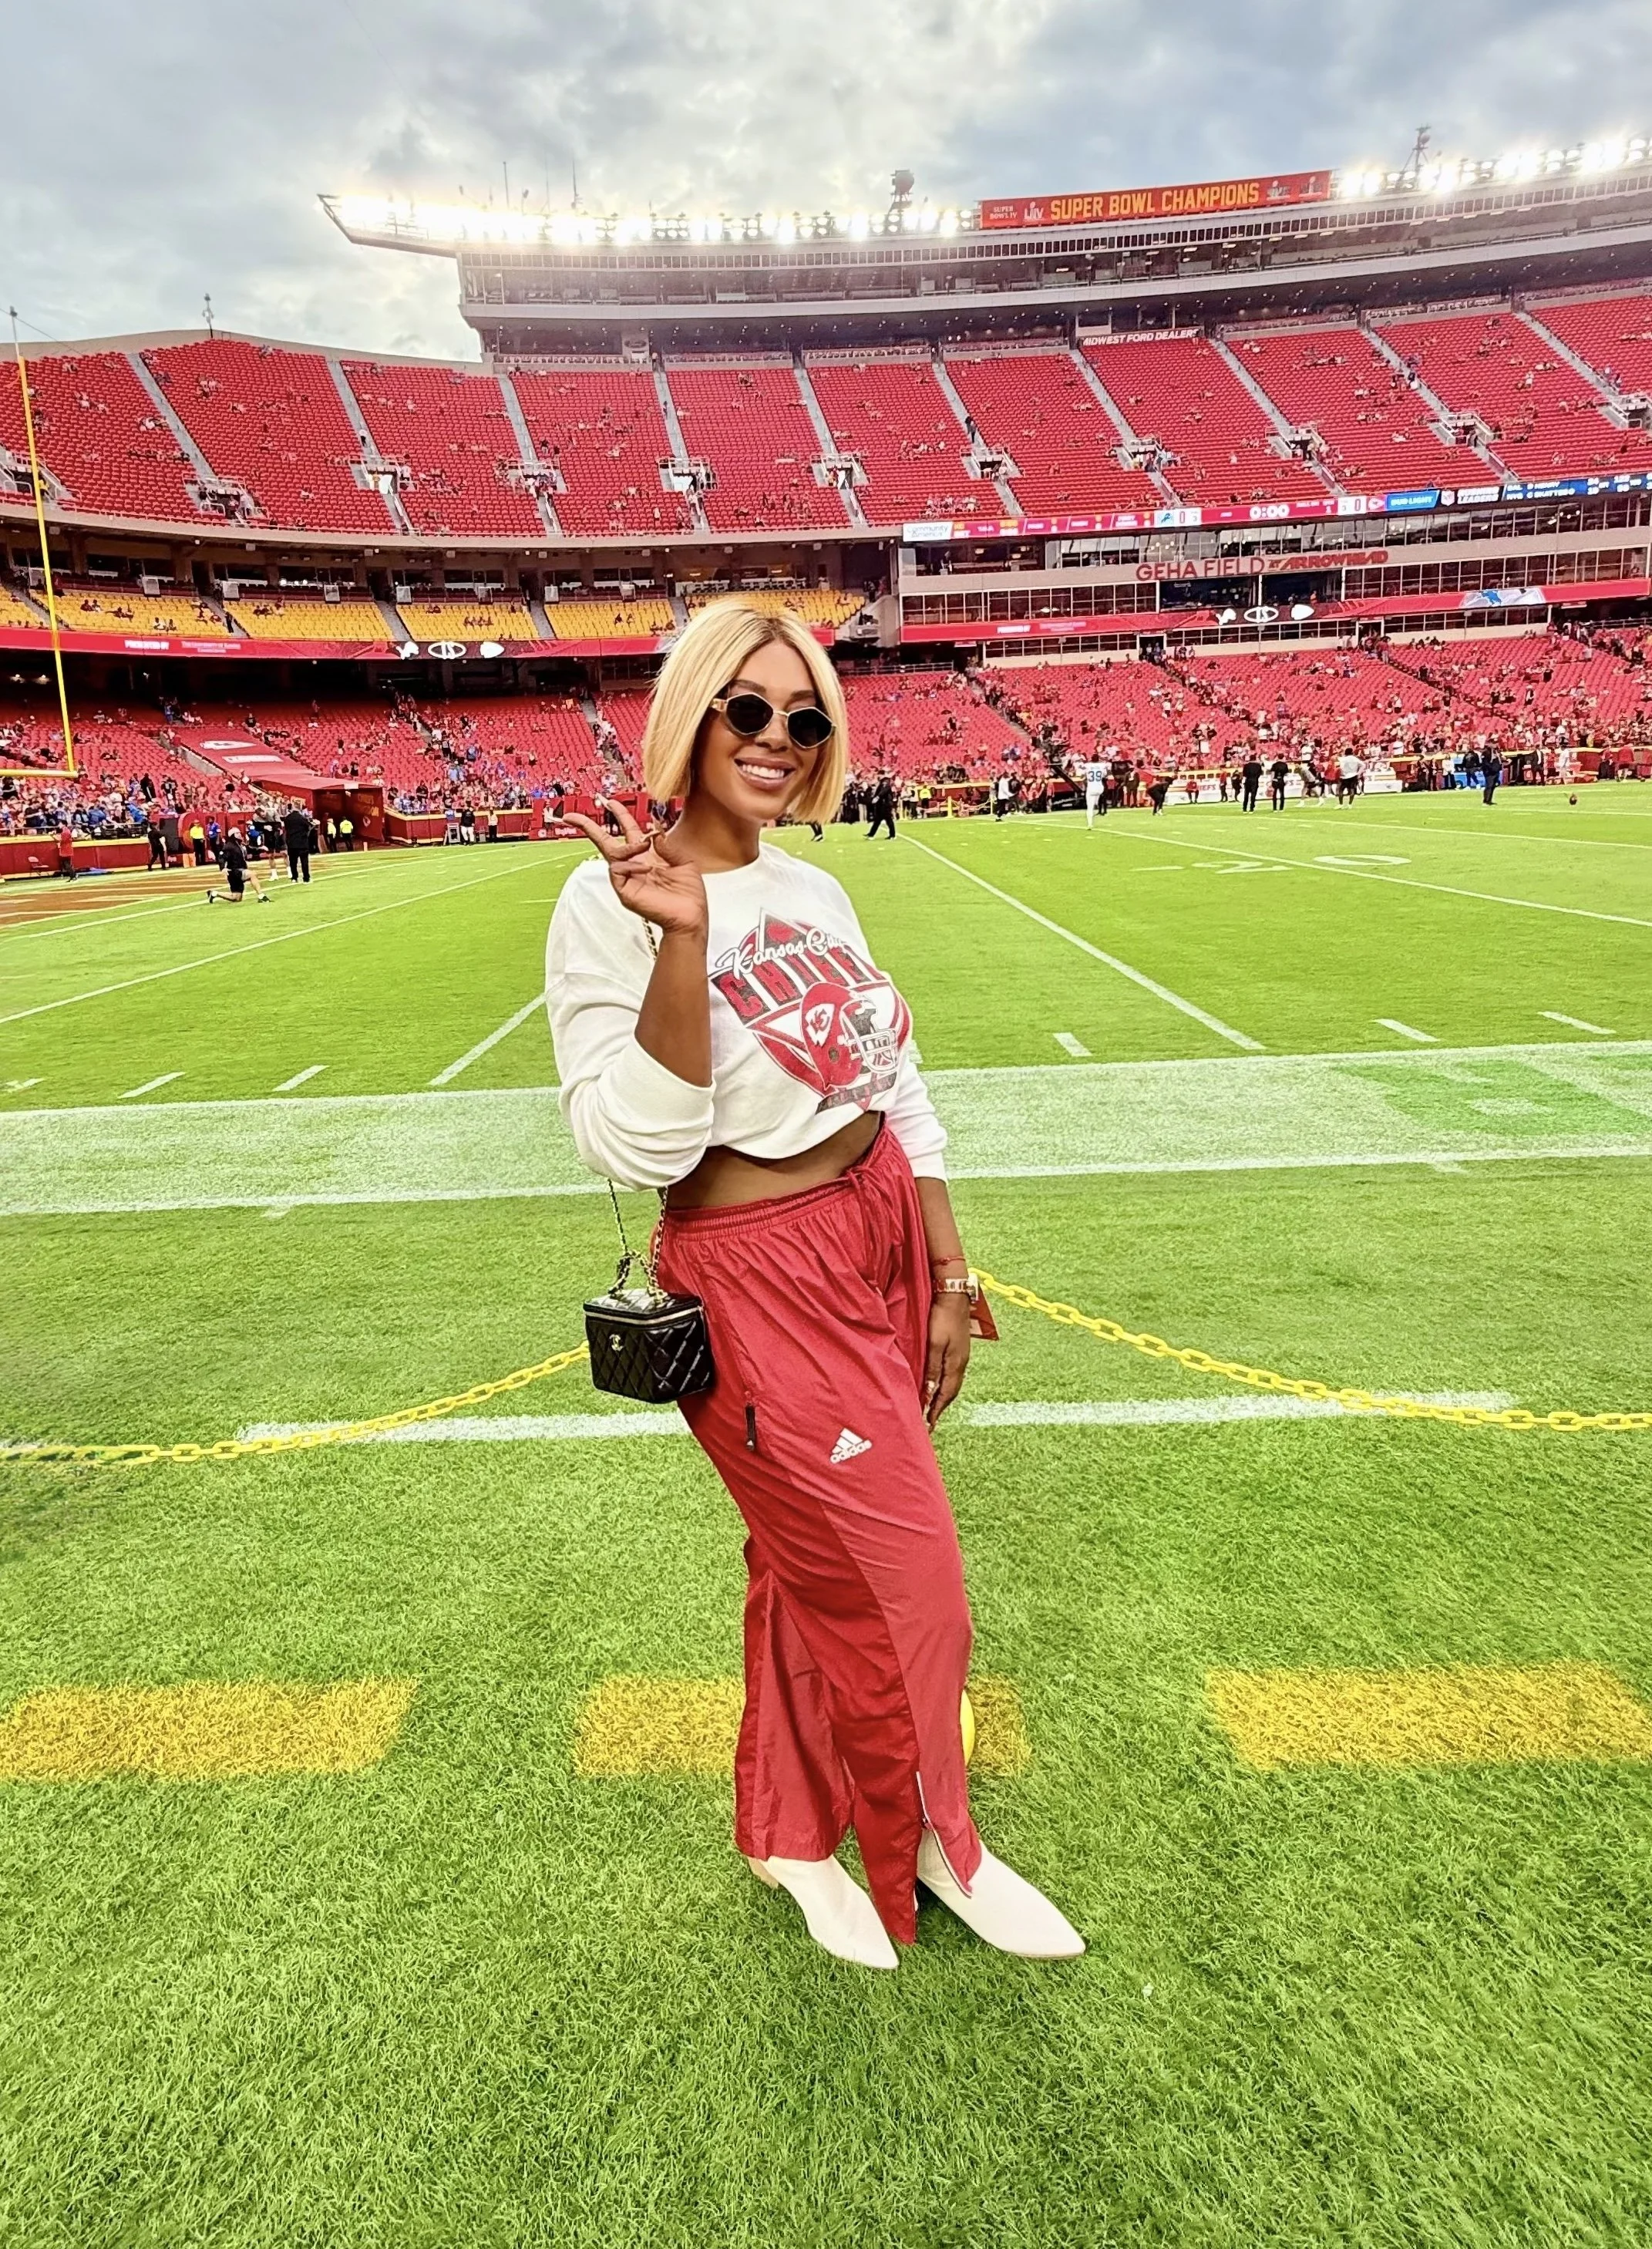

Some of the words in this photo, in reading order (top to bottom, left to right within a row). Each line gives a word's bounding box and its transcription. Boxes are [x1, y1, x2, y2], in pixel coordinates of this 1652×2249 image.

[1050, 196, 1102, 221] SUPER
[1109, 192, 1156, 216] BOWL
[1161, 183, 1260, 211] CHAMPIONS
[1083, 335, 1125, 346] MIDWEST
[1126, 332, 1155, 343] FORD
[1156, 328, 1199, 341] DEALERS
[1354, 498, 1361, 510] 0
[1391, 498, 1408, 507] BUD
[1408, 496, 1434, 505] LIGHT
[1179, 511, 1186, 524] 0
[1249, 504, 1290, 520] 0:00
[907, 524, 948, 533] Community
[1136, 562, 1197, 581] GEHA
[1204, 557, 1265, 577] FIELD
[1281, 550, 1388, 570] ARROWHEAD
[715, 943, 807, 979] Kansas
[719, 945, 887, 1018] CHIEF
[829, 1439, 873, 1464] adidas
